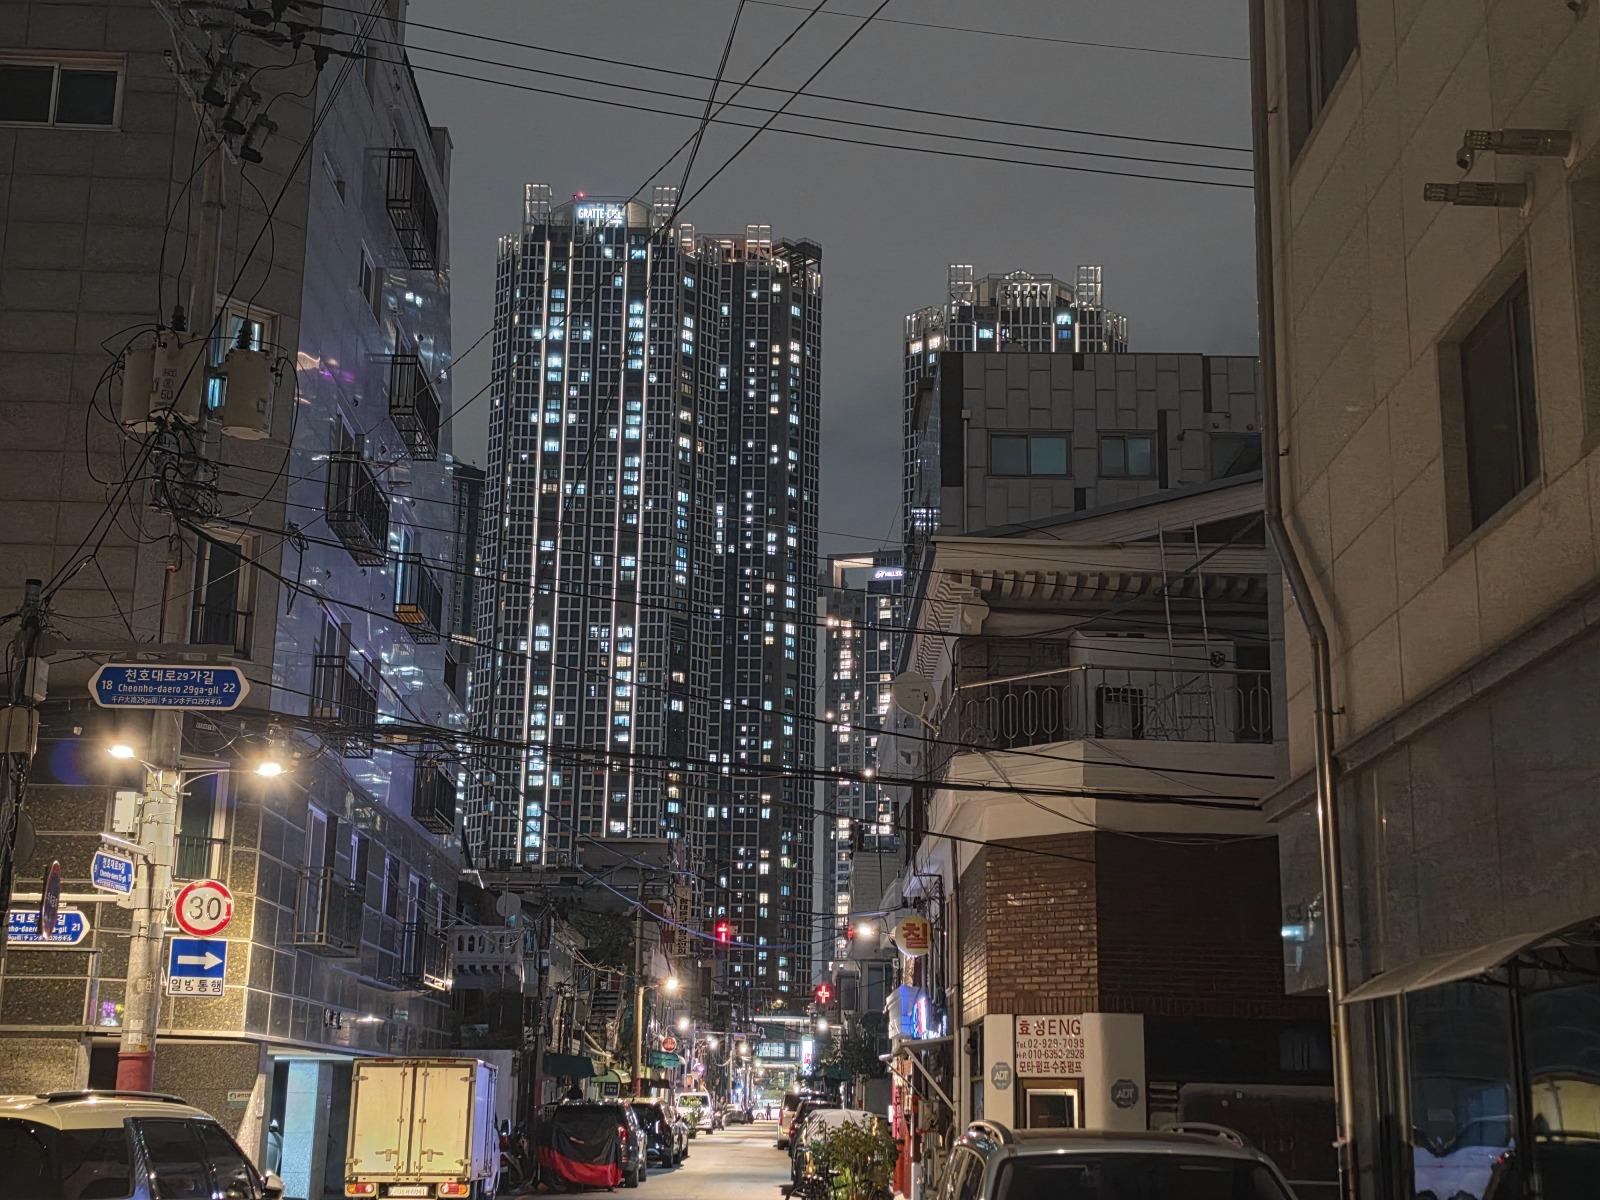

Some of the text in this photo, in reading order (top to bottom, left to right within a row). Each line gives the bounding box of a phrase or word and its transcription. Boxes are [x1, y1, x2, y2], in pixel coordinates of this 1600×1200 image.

[125, 668, 214, 685] 천호대로29가길
[102, 680, 113, 690] 18
[118, 683, 219, 696] Cheonho-daero 29ga-gil
[222, 683, 236, 693] 22
[188, 896, 222, 921] 30
[72, 923, 81, 931] 21
[902, 922, 929, 949] 칠
[171, 978, 222, 993] 일방통행
[993, 1070, 1009, 1081] ADT
[1116, 1088, 1135, 1098] ADT
